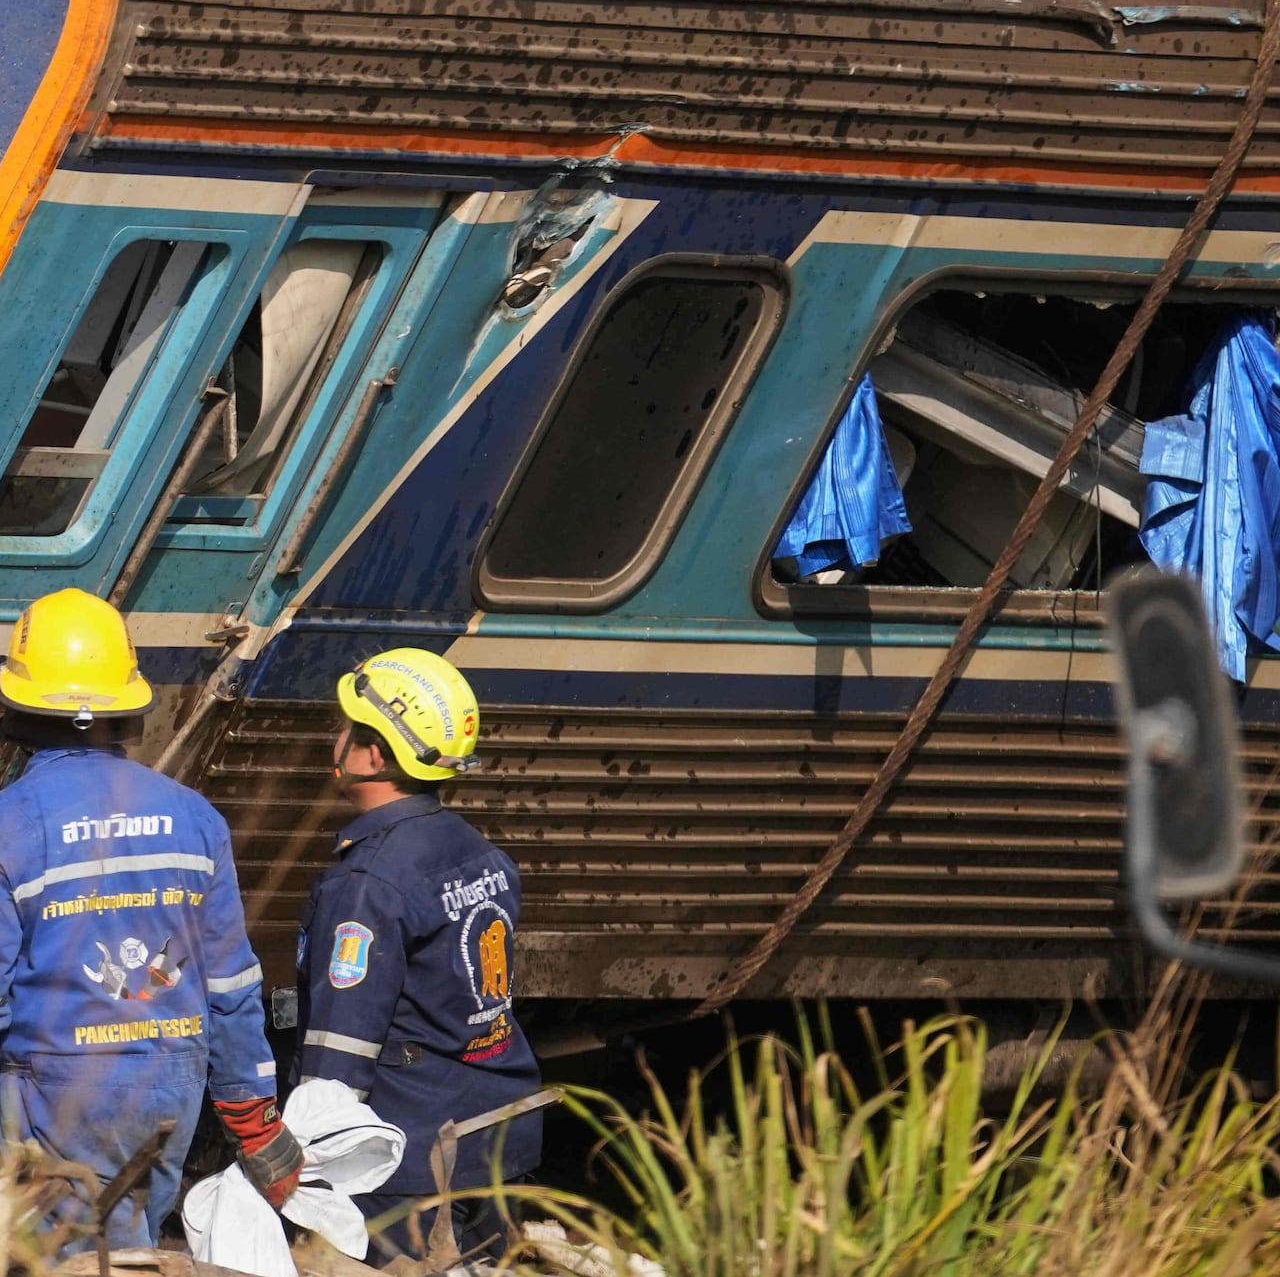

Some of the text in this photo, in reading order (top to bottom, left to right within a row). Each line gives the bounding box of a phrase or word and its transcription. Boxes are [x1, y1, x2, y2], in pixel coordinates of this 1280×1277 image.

[370, 660, 413, 676] SEARCH
[412, 672, 434, 693] AND
[379, 704, 395, 720] LED
[433, 693, 454, 741] RESCUE
[62, 813, 174, 845] สว่างวิชชา
[75, 1019, 159, 1045] PAKCHONG
